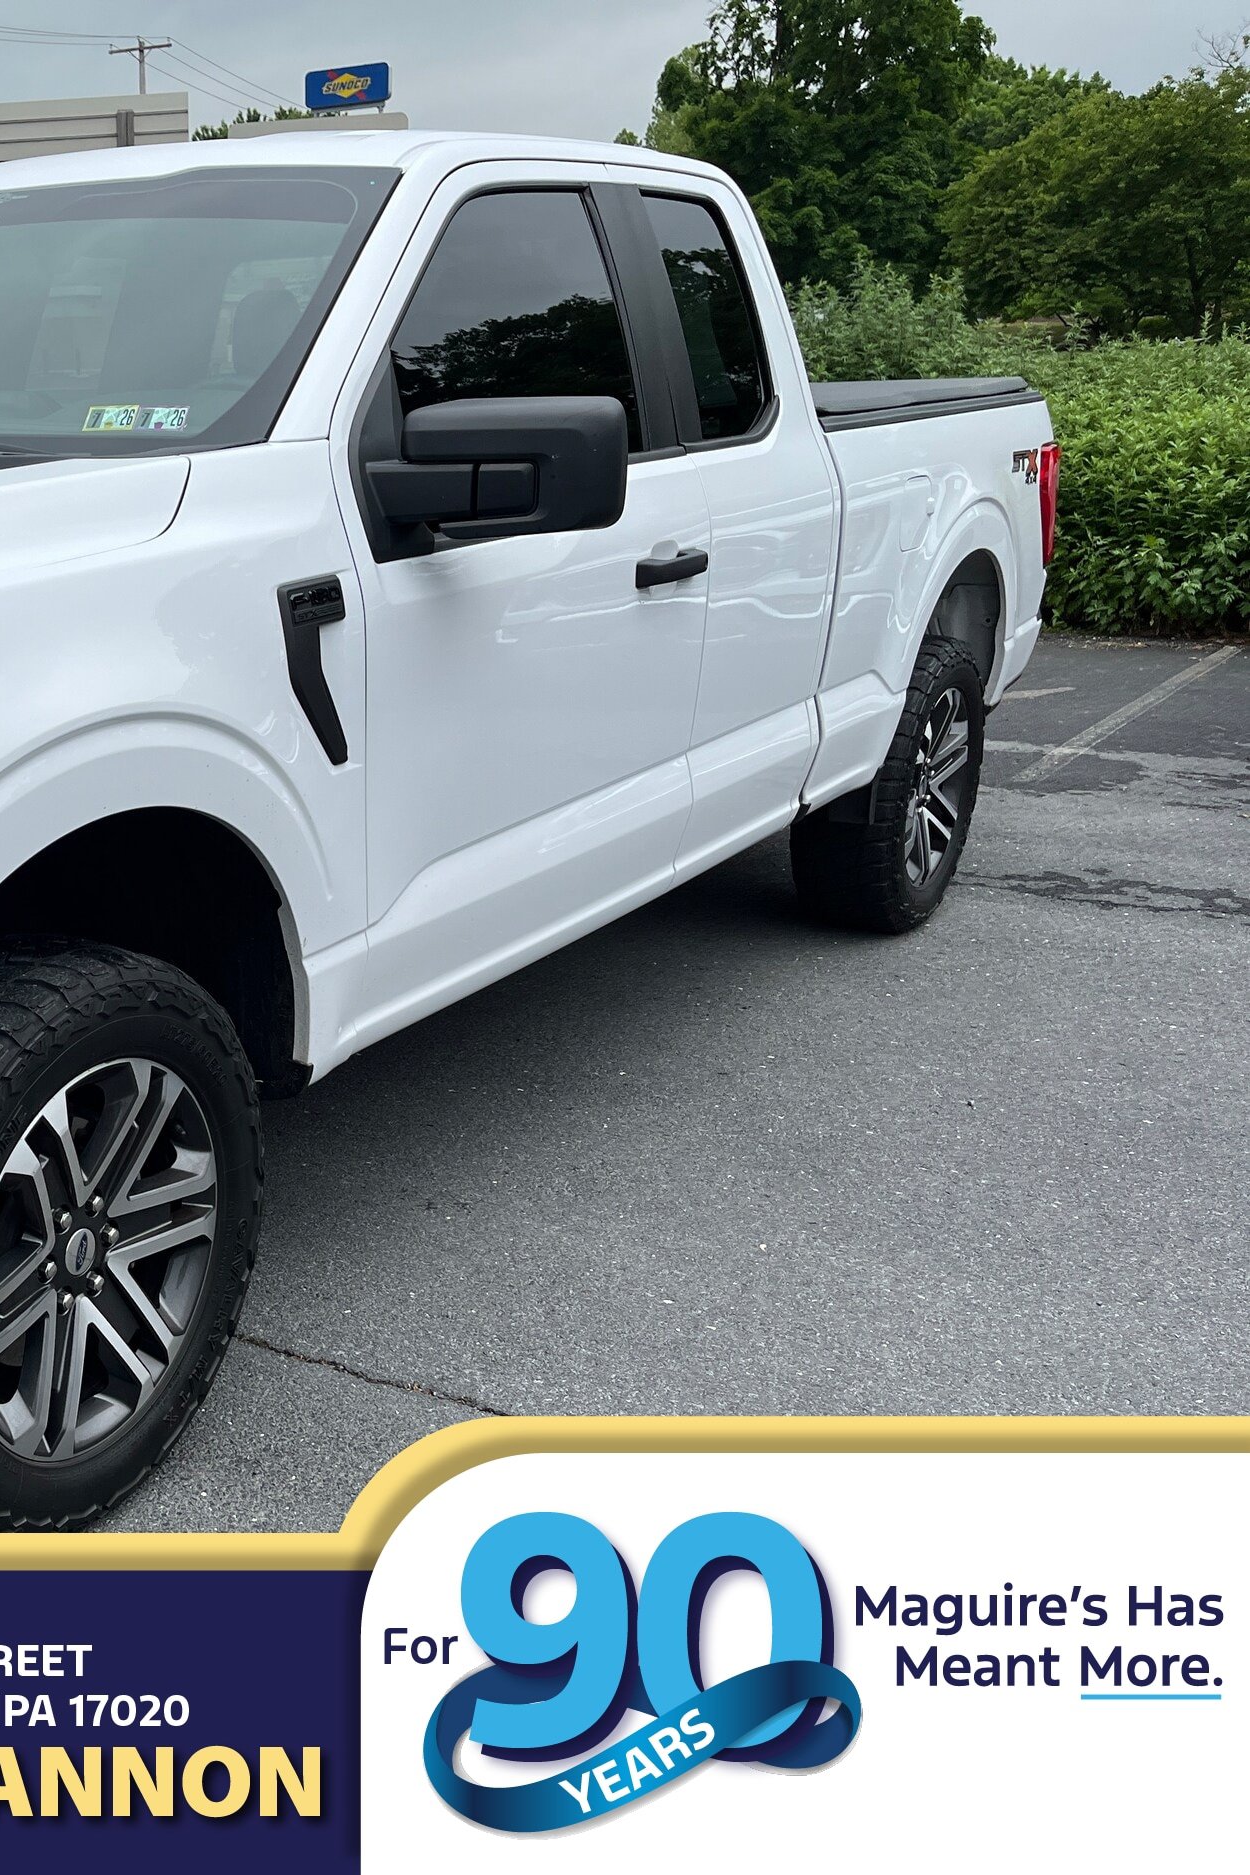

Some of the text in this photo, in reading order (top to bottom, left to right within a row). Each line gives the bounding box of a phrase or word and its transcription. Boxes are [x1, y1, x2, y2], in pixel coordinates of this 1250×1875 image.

[324, 78, 370, 93] SUNOCO
[91, 408, 136, 428] 7 26
[141, 409, 186, 428] 7 26
[1012, 448, 1038, 476] STX
